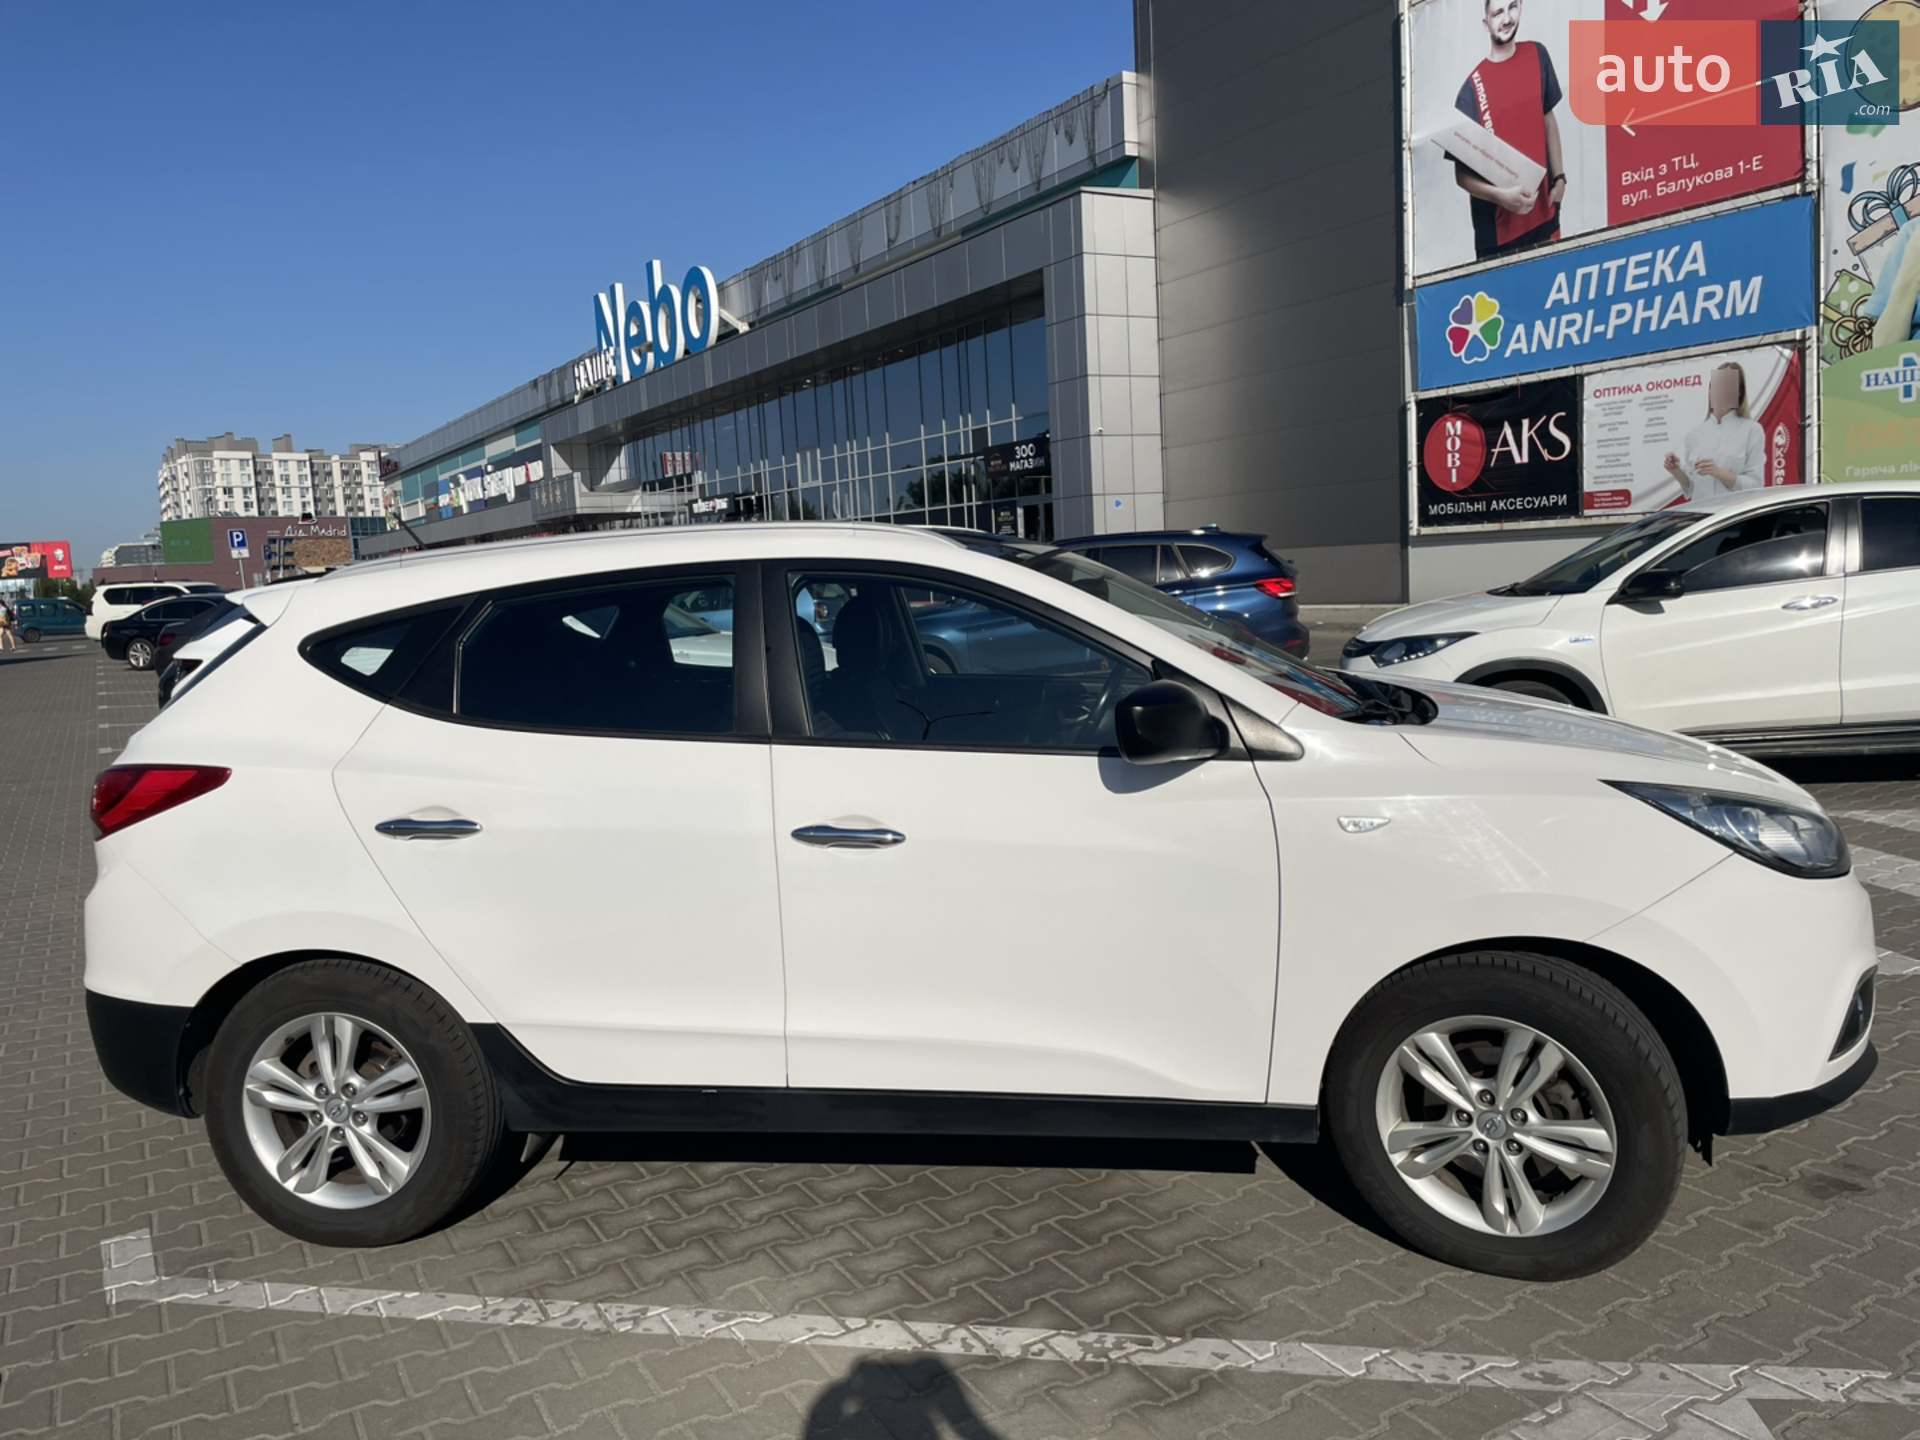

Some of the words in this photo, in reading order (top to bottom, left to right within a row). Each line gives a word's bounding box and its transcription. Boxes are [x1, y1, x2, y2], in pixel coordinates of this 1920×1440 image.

[1621, 166, 1655, 186] Вхід
[1658, 163, 1668, 176] з
[1621, 189, 1652, 207] вул.
[1656, 166, 1734, 196] Балукова
[1737, 154, 1764, 175] 1-Е
[1544, 240, 1707, 310] АПТЕКА
[593, 258, 720, 385] Nebo
[1503, 275, 1764, 358] ANRI-PHARM
[1593, 383, 1643, 400] ОПТИКА
[1645, 374, 1703, 393] ОКОМЕД
[1865, 367, 1920, 389] НАШ
[1445, 420, 1463, 484] МОВІ
[1490, 411, 1572, 468] AKS
[1845, 464, 1896, 478] Гаряча
[1428, 500, 1487, 516] МОБІЛЬНІ
[1490, 494, 1568, 512] АКСЕСУАРИ
[232, 531, 244, 548] P
[310, 525, 347, 537] Madrid
